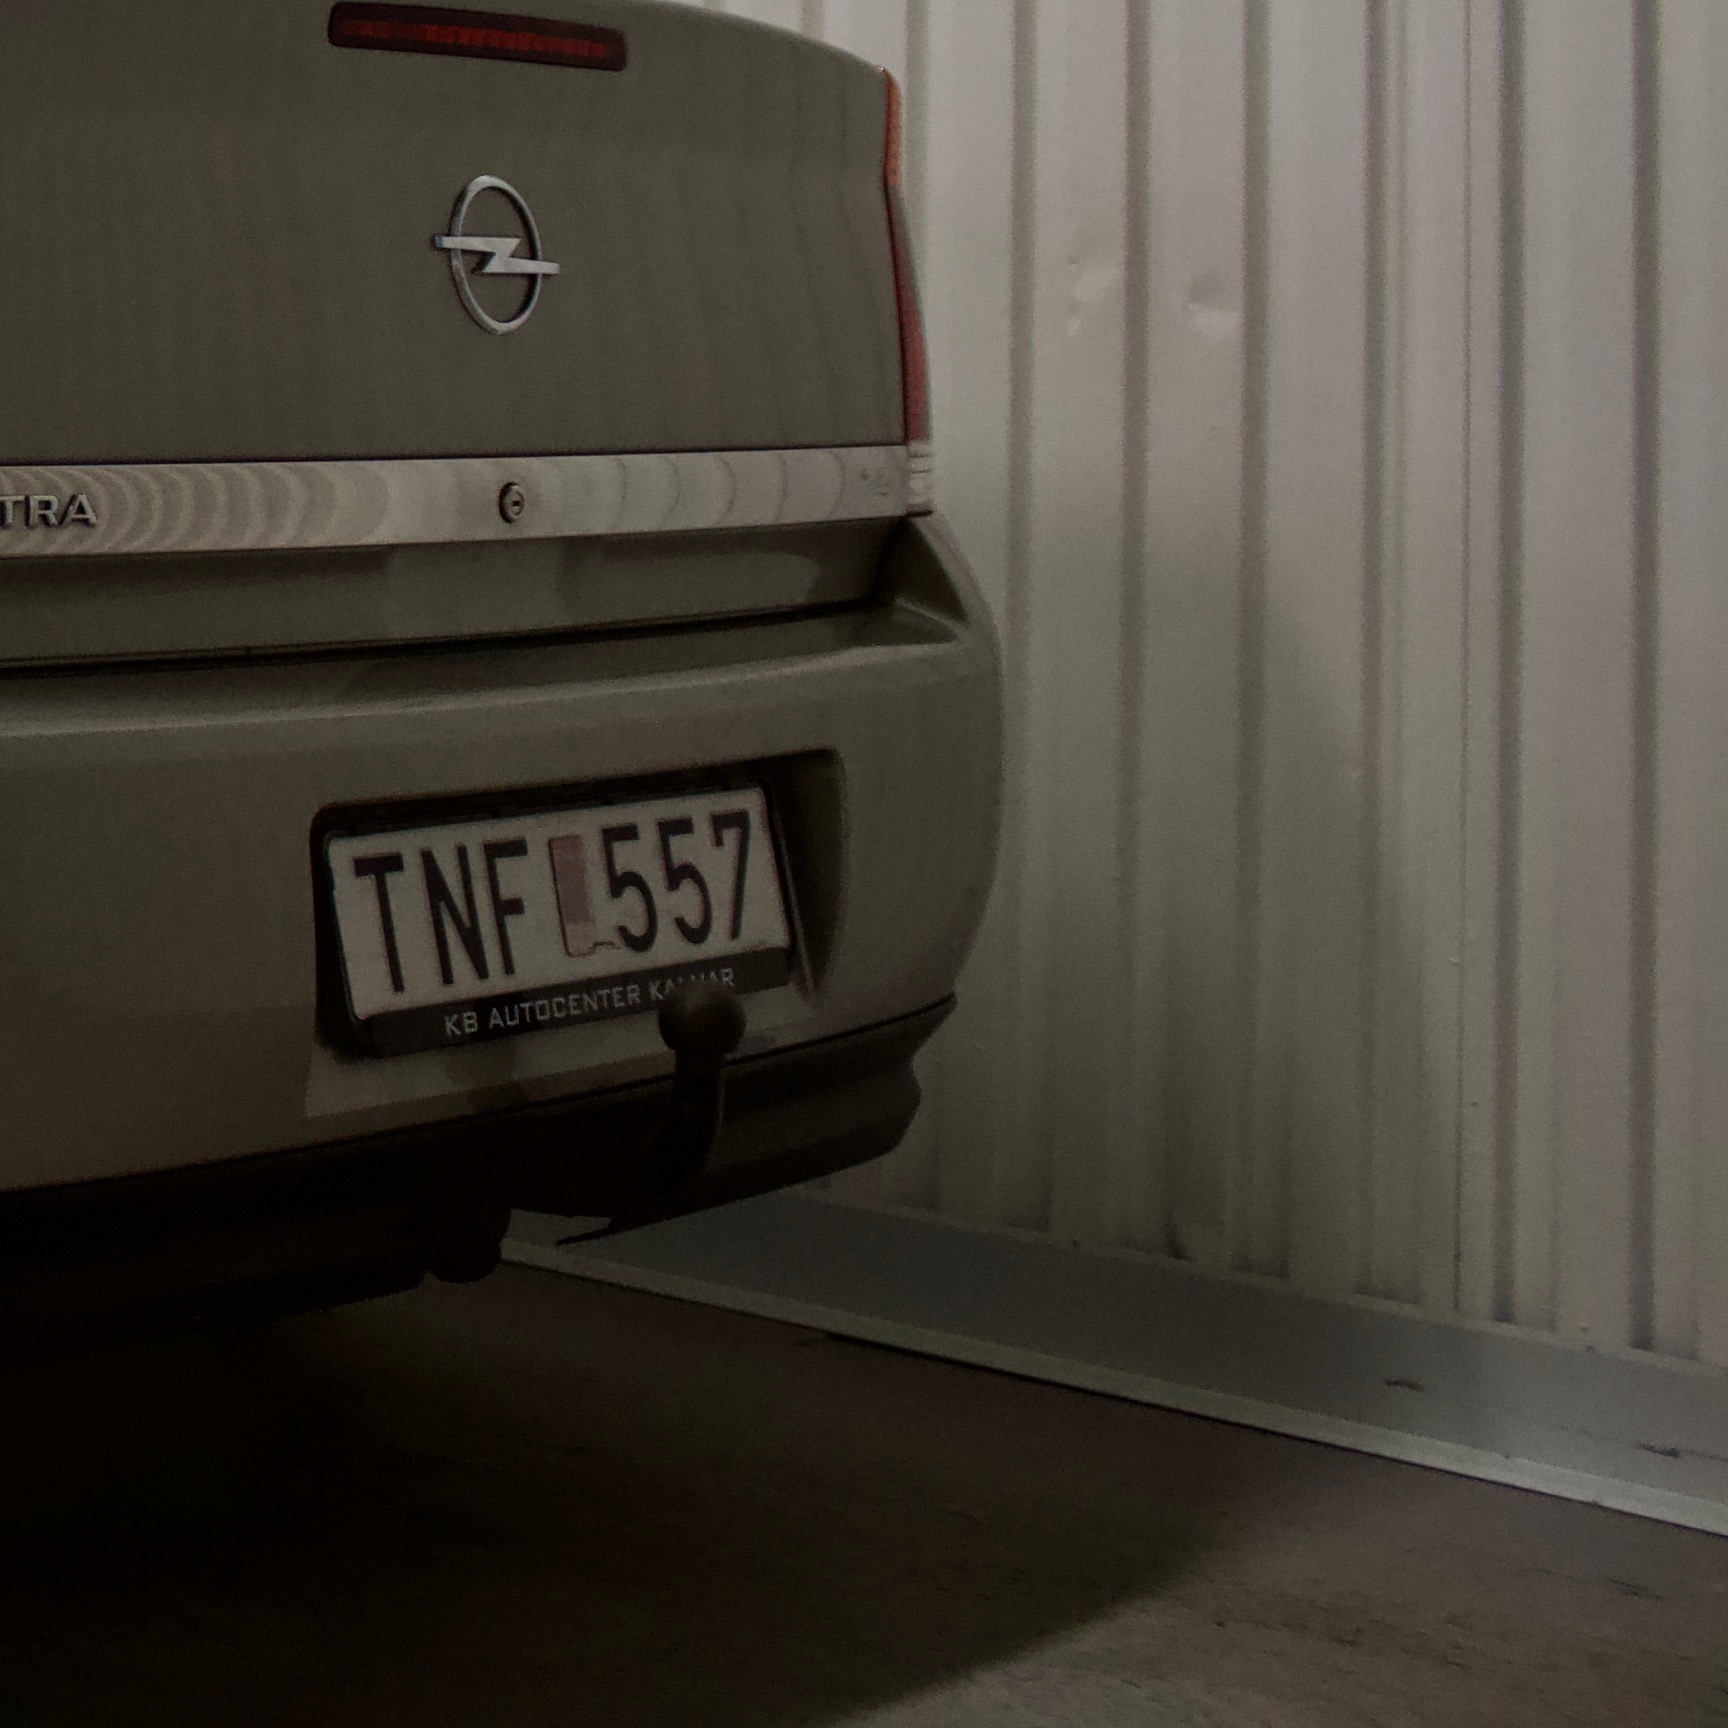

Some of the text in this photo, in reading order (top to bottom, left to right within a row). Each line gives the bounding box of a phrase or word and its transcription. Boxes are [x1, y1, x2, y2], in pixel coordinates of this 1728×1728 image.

[353, 810, 750, 993] TNF 557
[443, 1011, 479, 1038] KB
[488, 983, 641, 1030] AUTOCENTER
